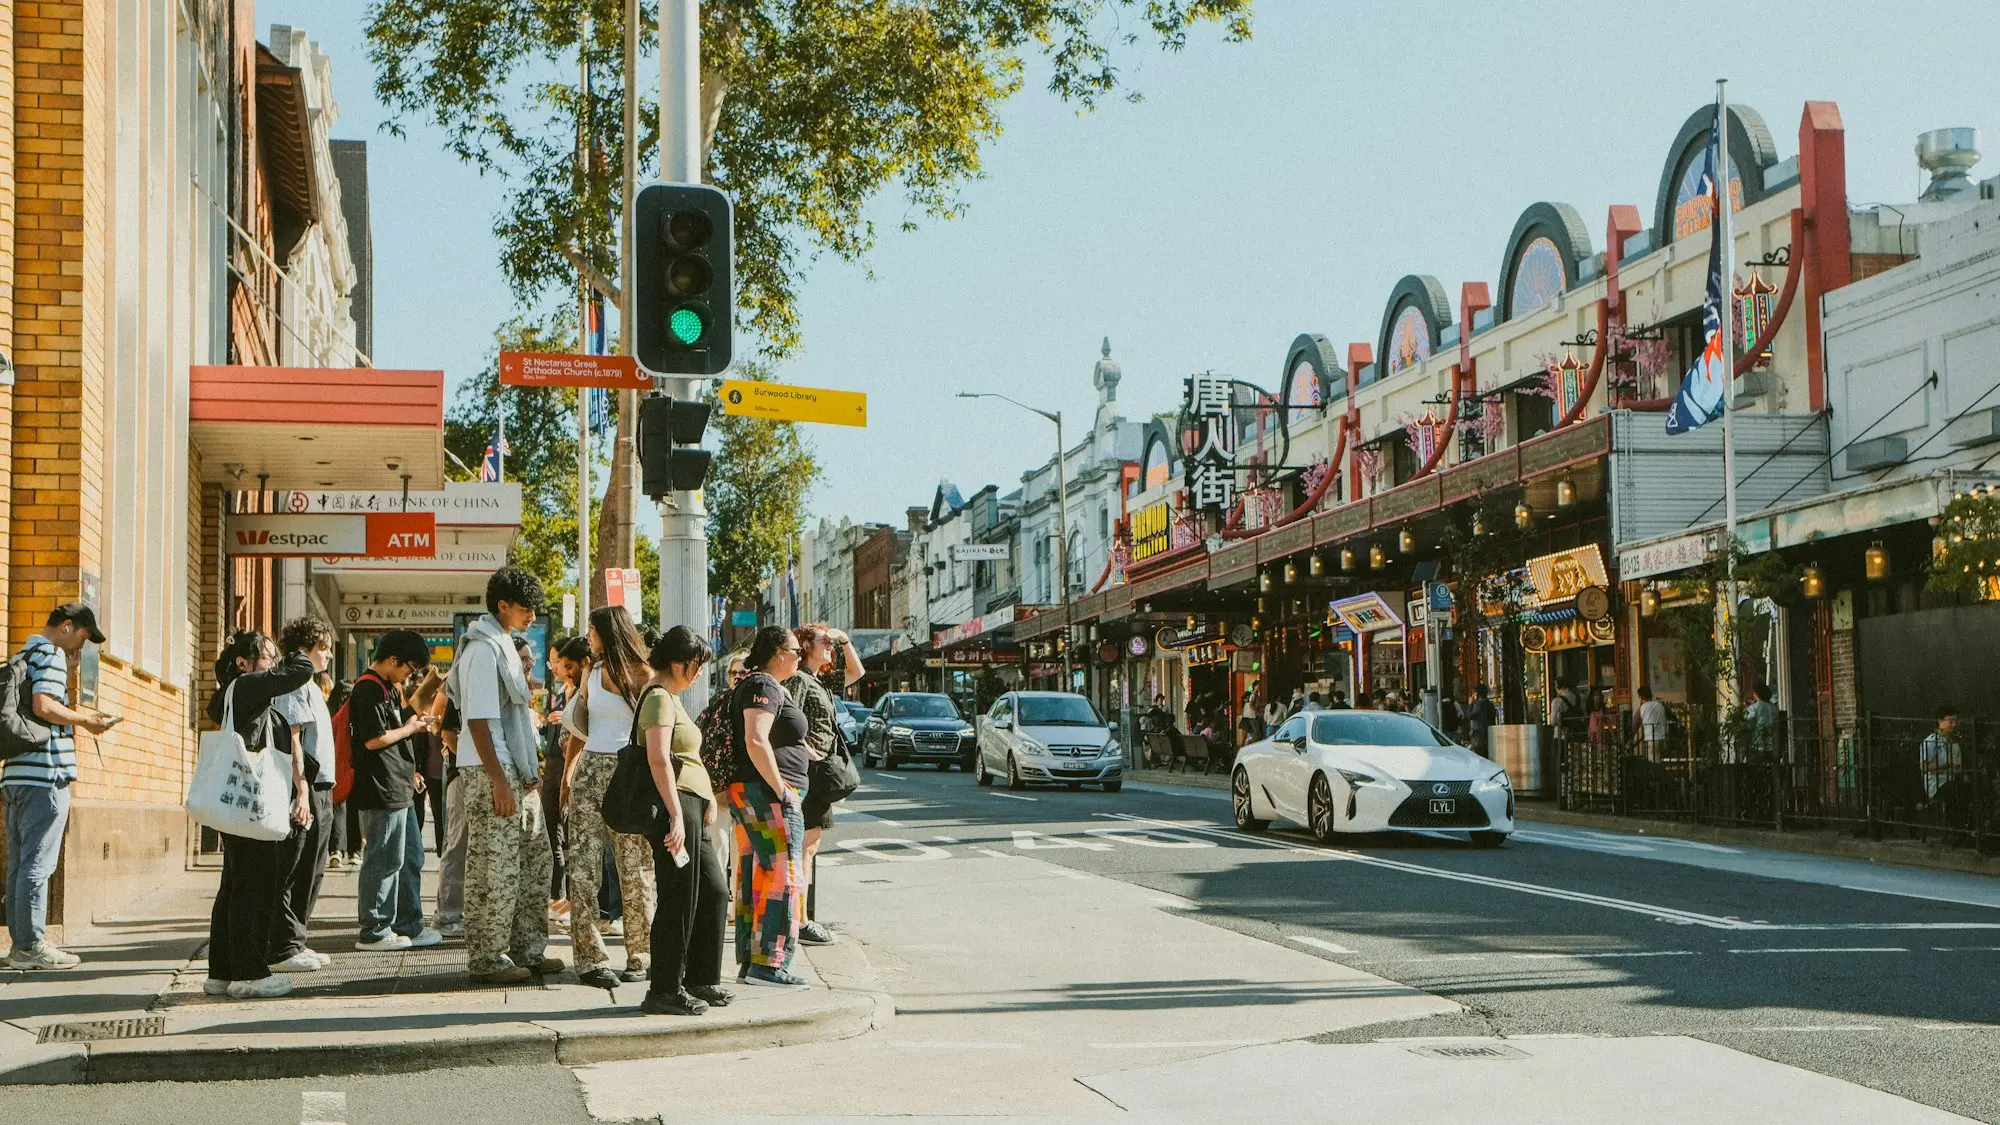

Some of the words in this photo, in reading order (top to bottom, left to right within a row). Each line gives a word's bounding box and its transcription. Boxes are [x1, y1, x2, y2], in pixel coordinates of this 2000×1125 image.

[522, 357, 533, 366] St
[534, 358, 572, 368] Nectarios
[573, 360, 598, 369] Greek
[522, 366, 562, 375] Orthodox
[563, 368, 593, 377] Church
[594, 369, 623, 379] (c.1879)
[754, 387, 789, 399] Burwood
[790, 391, 817, 403] Library
[1189, 374, 1237, 510] 唐人街
[389, 496, 427, 508] BANK
[431, 497, 448, 508] OF
[453, 497, 500, 509] CHINA
[235, 530, 329, 548] Westpac
[387, 532, 430, 548] ATM
[440, 552, 454, 561] OF
[458, 552, 496, 562] CHINA
[1621, 554, 1640, 576] 123-125
[411, 610, 437, 618] BANK
[752, 694, 769, 705] ive
[1433, 802, 1451, 812] LYL
[1011, 829, 1220, 851] 40
